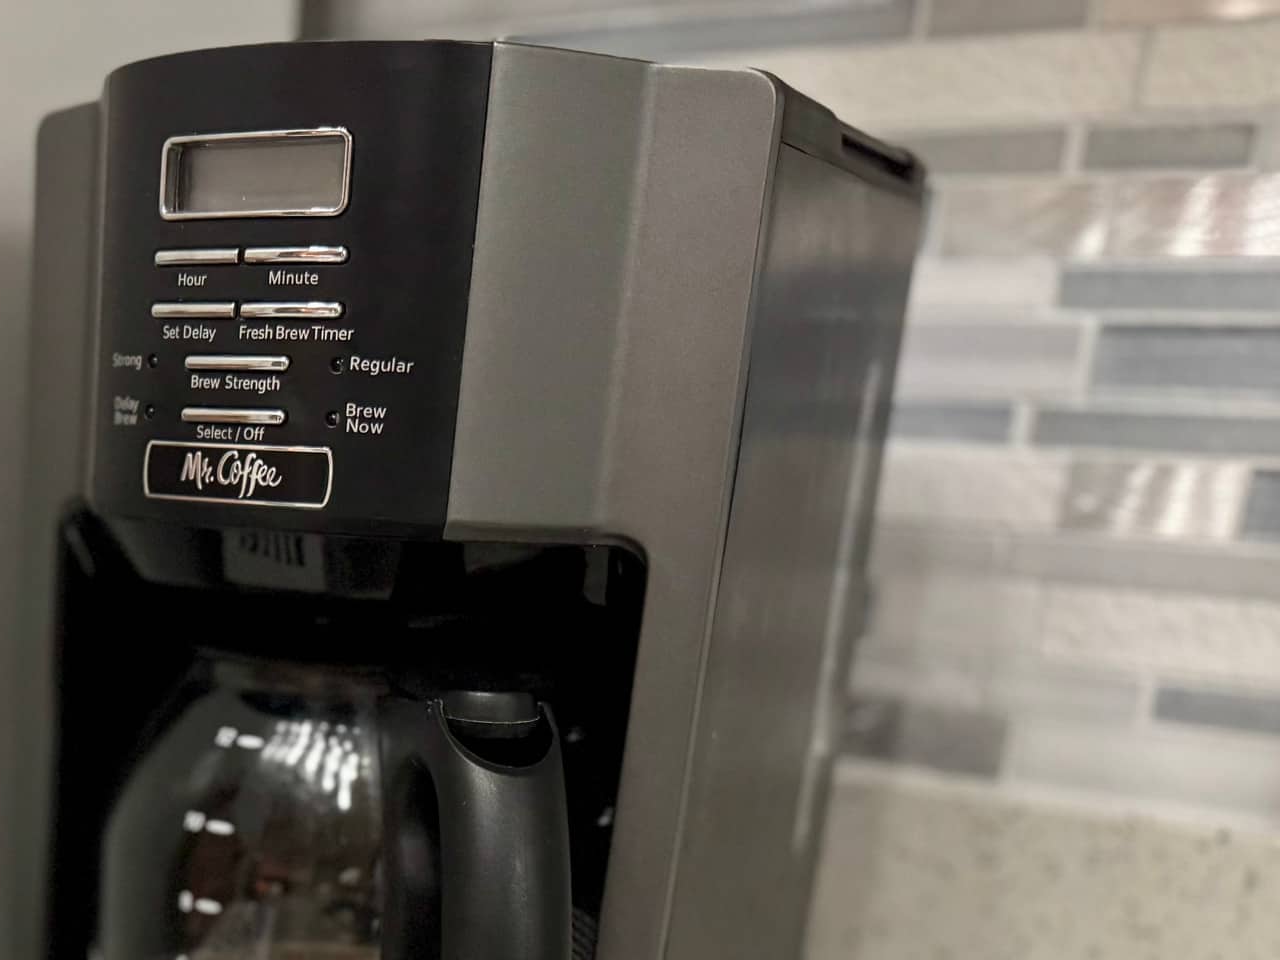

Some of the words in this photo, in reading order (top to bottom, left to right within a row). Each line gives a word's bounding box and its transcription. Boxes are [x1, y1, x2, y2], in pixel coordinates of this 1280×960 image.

[177, 273, 208, 287] Hour
[268, 270, 320, 286] Minute
[162, 326, 181, 340] Set
[183, 326, 217, 344] Delay
[239, 325, 273, 340] Fresh
[276, 326, 310, 341] Brew
[312, 326, 355, 342] Timer
[349, 356, 415, 376] Regular
[190, 375, 220, 390] Brew
[225, 376, 281, 394] Strength
[345, 403, 387, 419] Brew
[196, 426, 233, 440] Select
[243, 427, 265, 441] Off
[345, 420, 385, 435] Now
[181, 452, 214, 489] Mr.
[218, 450, 282, 498] Coffee
